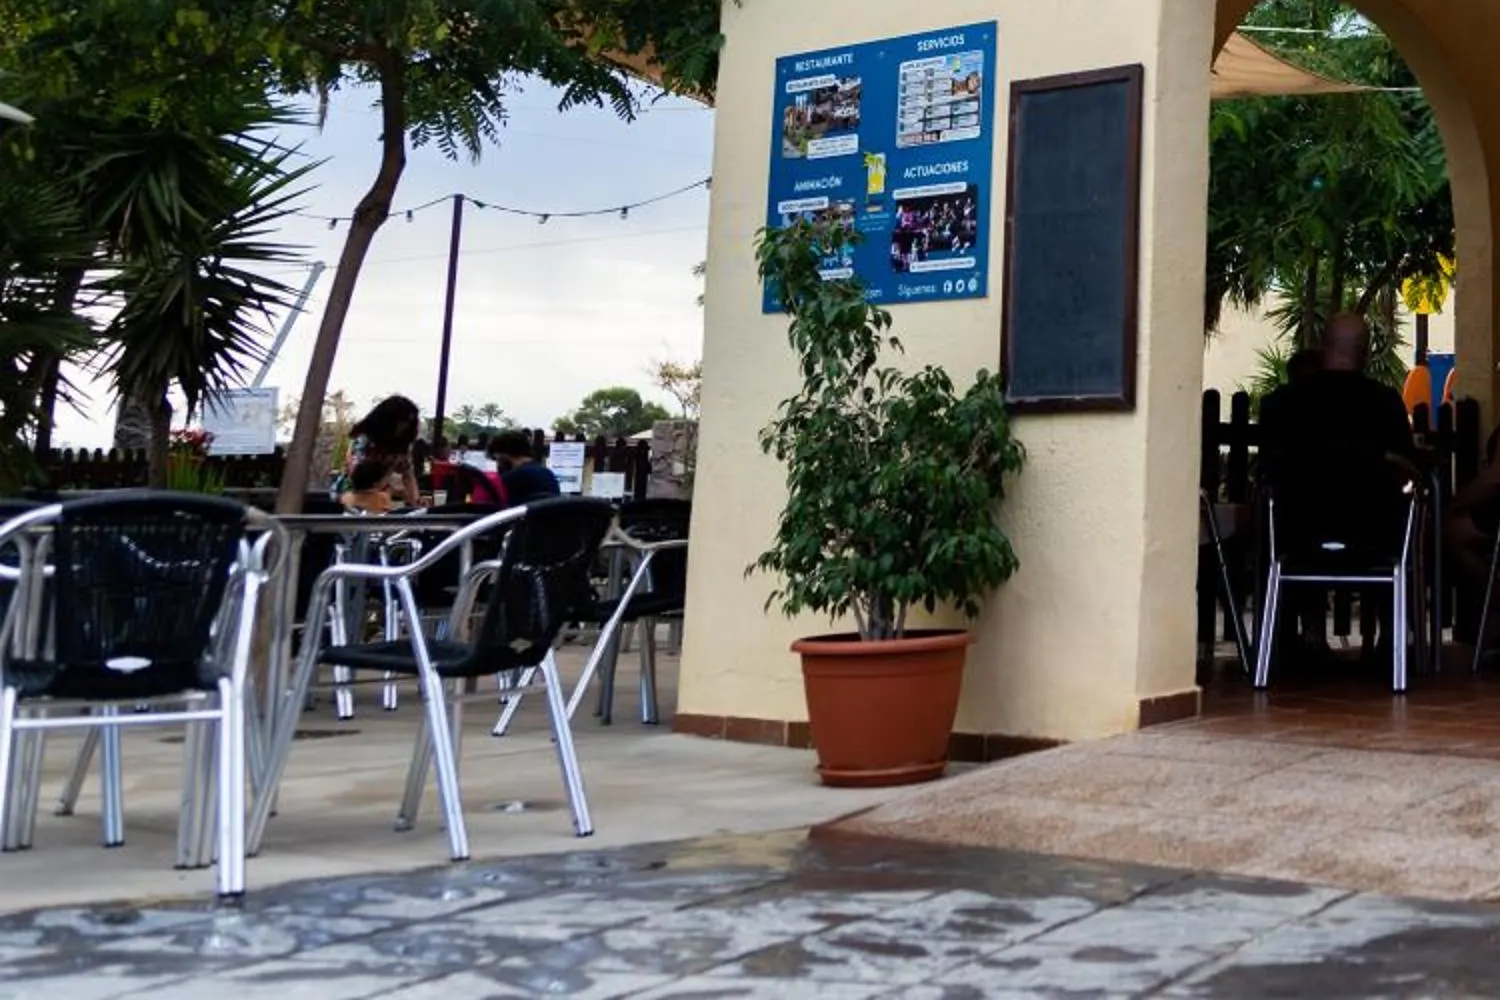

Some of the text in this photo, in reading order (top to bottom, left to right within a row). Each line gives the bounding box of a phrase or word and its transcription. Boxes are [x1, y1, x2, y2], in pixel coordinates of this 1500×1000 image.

[917, 34, 965, 52] SERVICIOS
[795, 53, 854, 72] RESTAURANTE
[903, 160, 969, 178] ACTUACIONES
